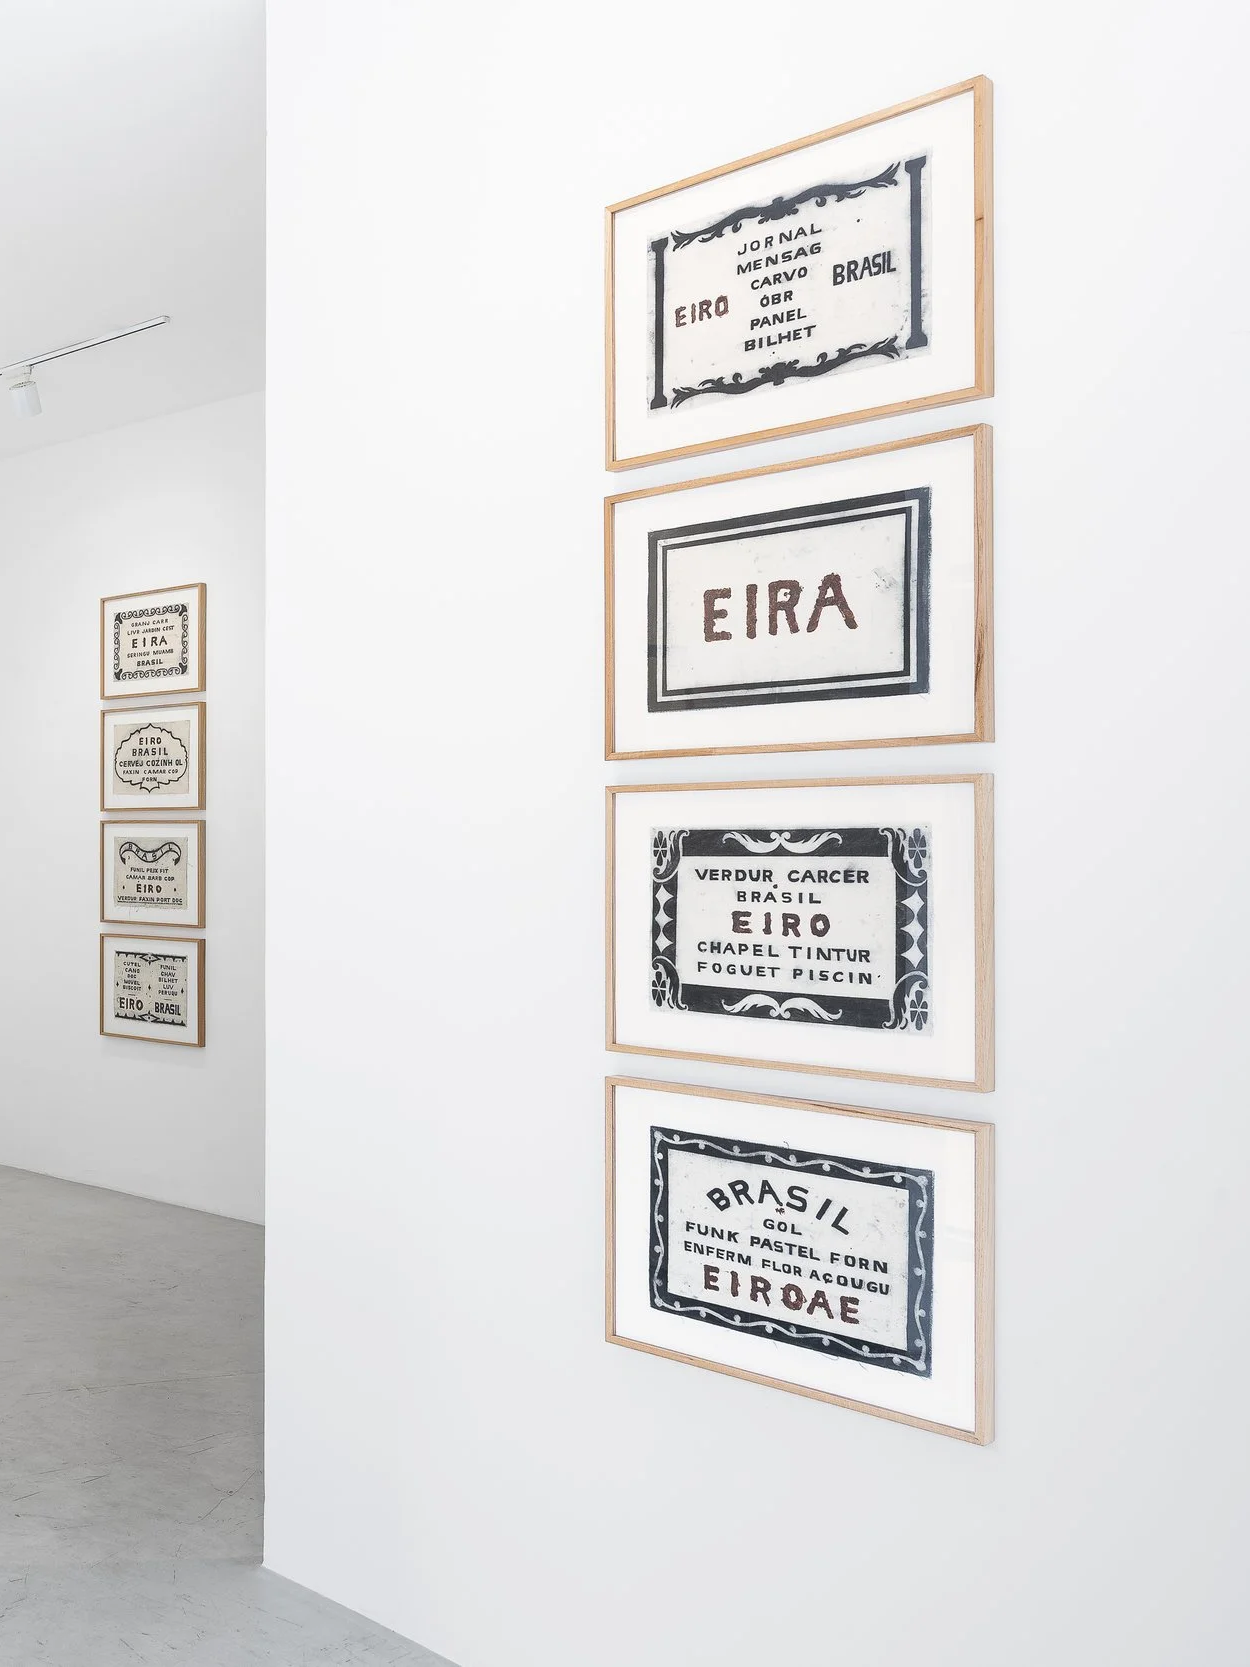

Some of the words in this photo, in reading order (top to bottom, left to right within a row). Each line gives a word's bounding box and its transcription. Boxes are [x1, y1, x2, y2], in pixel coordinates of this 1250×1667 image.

[737, 223, 822, 256] JORNAL
[736, 242, 822, 275] MENSAG
[832, 250, 897, 287] BRASIL
[750, 266, 808, 291] CARVO
[674, 294, 729, 328] EIRO
[749, 308, 807, 331] PANEL
[744, 325, 817, 352] BILHET
[703, 572, 858, 643] EIRA
[131, 635, 167, 649] EIRA
[136, 659, 163, 667] BRASIL
[132, 747, 168, 756] BRASIL
[139, 737, 162, 745] EIRO
[146, 759, 173, 767] COZINH
[128, 843, 172, 860] BRASIL
[136, 883, 162, 893] EIRO
[694, 868, 773, 883] VERDUR
[787, 869, 870, 885] CARCER
[736, 890, 822, 905] BRASIL
[731, 910, 831, 938] EIRO
[696, 940, 780, 959] CHAPEL
[788, 945, 871, 963] TINTUR
[697, 961, 781, 979] FOGUET
[792, 968, 873, 985] PISCIN
[119, 996, 143, 1011] EIRO
[154, 1002, 181, 1016] BRASIL
[706, 1178, 850, 1236] BRASIL
[762, 1218, 803, 1236] GOL
[685, 1220, 740, 1244] FUNK
[750, 1235, 820, 1262] PASTEL
[830, 1251, 889, 1274] FORN
[683, 1240, 752, 1266] ENFERM
[761, 1258, 803, 1278] FLOR
[809, 1269, 891, 1296] AÇOUGU
[703, 1263, 860, 1325] EIROAE
